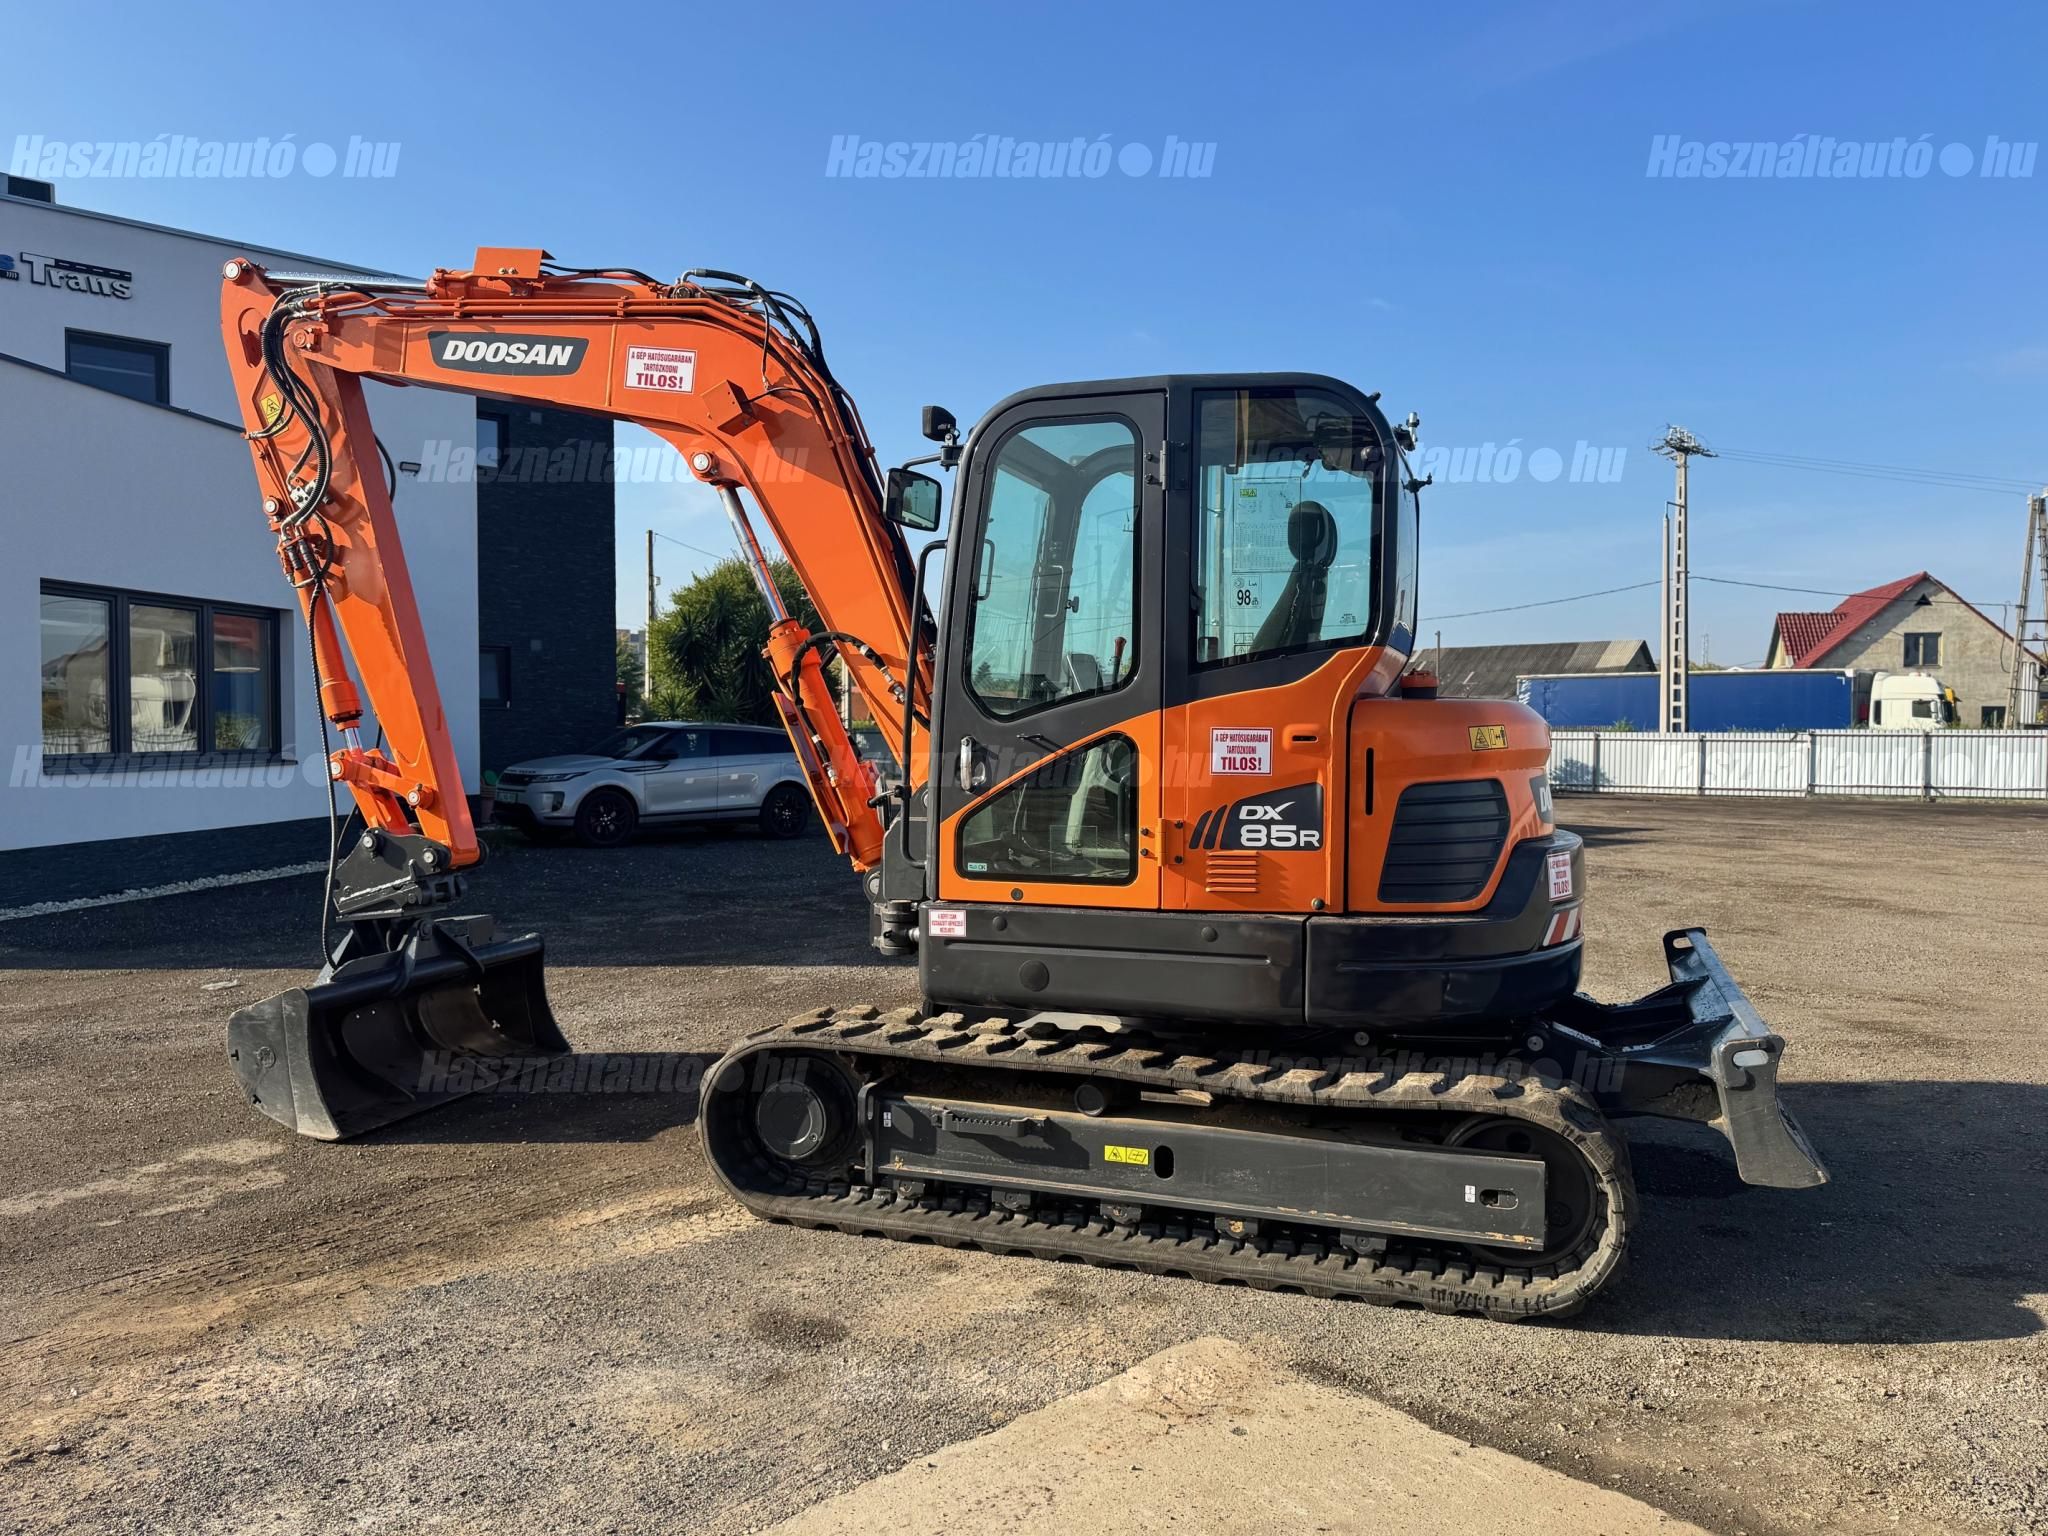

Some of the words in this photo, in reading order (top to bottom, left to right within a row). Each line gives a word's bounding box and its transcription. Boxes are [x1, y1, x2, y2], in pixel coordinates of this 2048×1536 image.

[20, 251, 132, 299] Trans
[442, 340, 573, 366] DOOSAN
[636, 373, 683, 388] TILOS!
[1237, 589, 1251, 606] 98
[1221, 757, 1262, 771] TILOS!
[1239, 801, 1296, 820] DX
[1240, 824, 1320, 848] 85R
